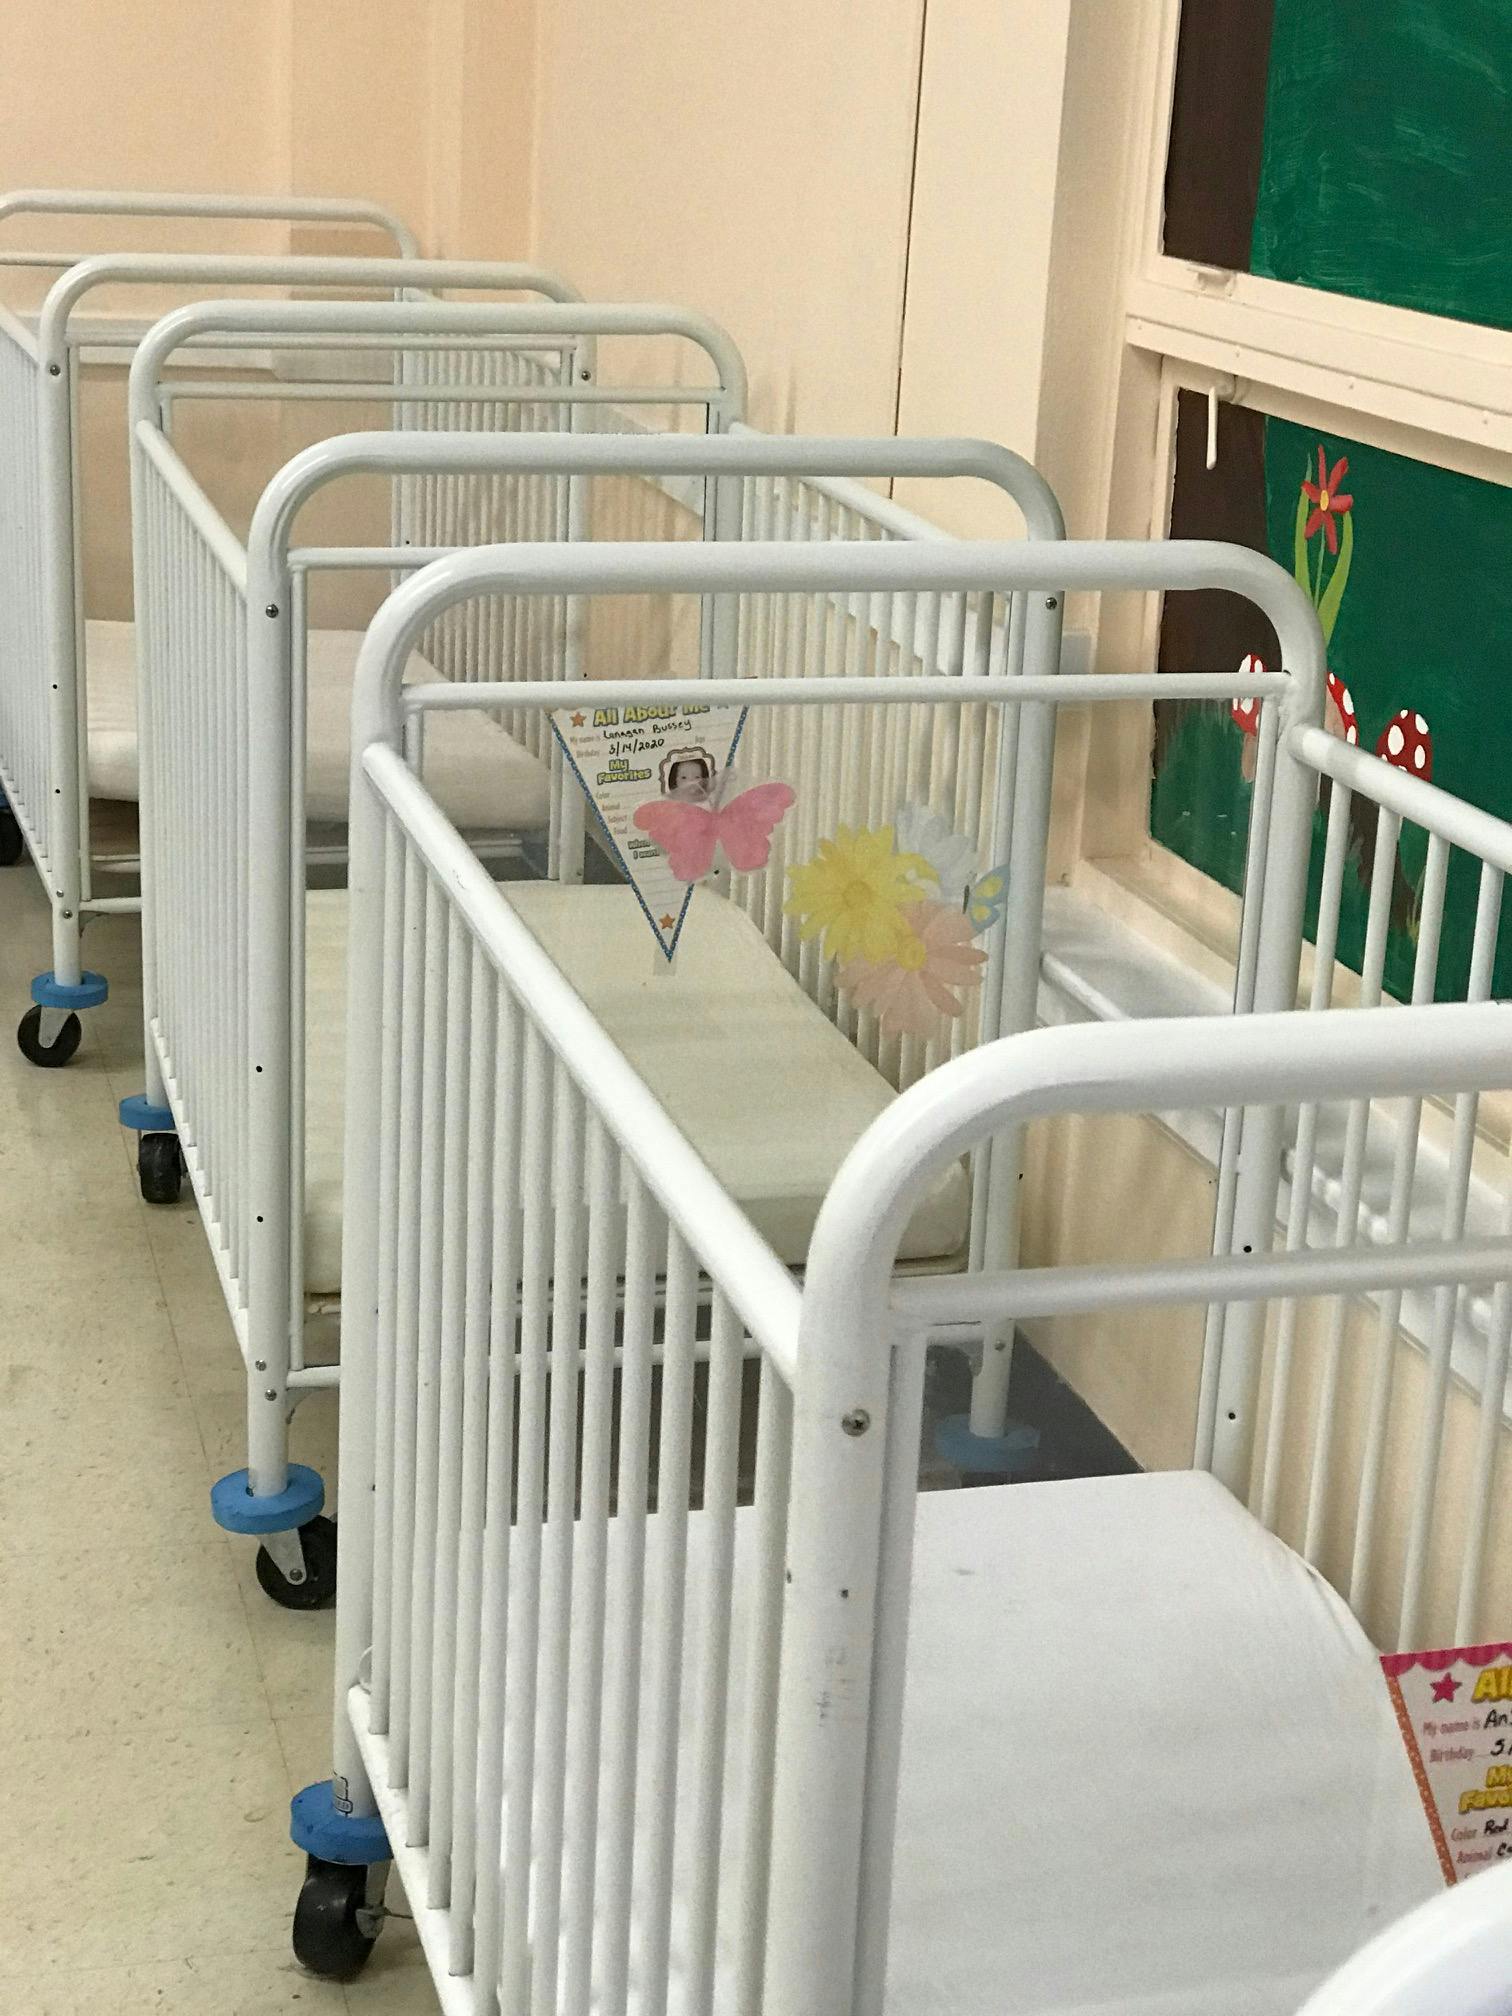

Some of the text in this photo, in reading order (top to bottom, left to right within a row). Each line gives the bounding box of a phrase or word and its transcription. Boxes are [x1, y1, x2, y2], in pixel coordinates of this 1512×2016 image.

[593, 707, 619, 727] All
[652, 719, 692, 734] Bussey
[609, 759, 629, 772] My
[597, 769, 651, 785] Favorites
[1451, 1826, 1478, 1842] Color
